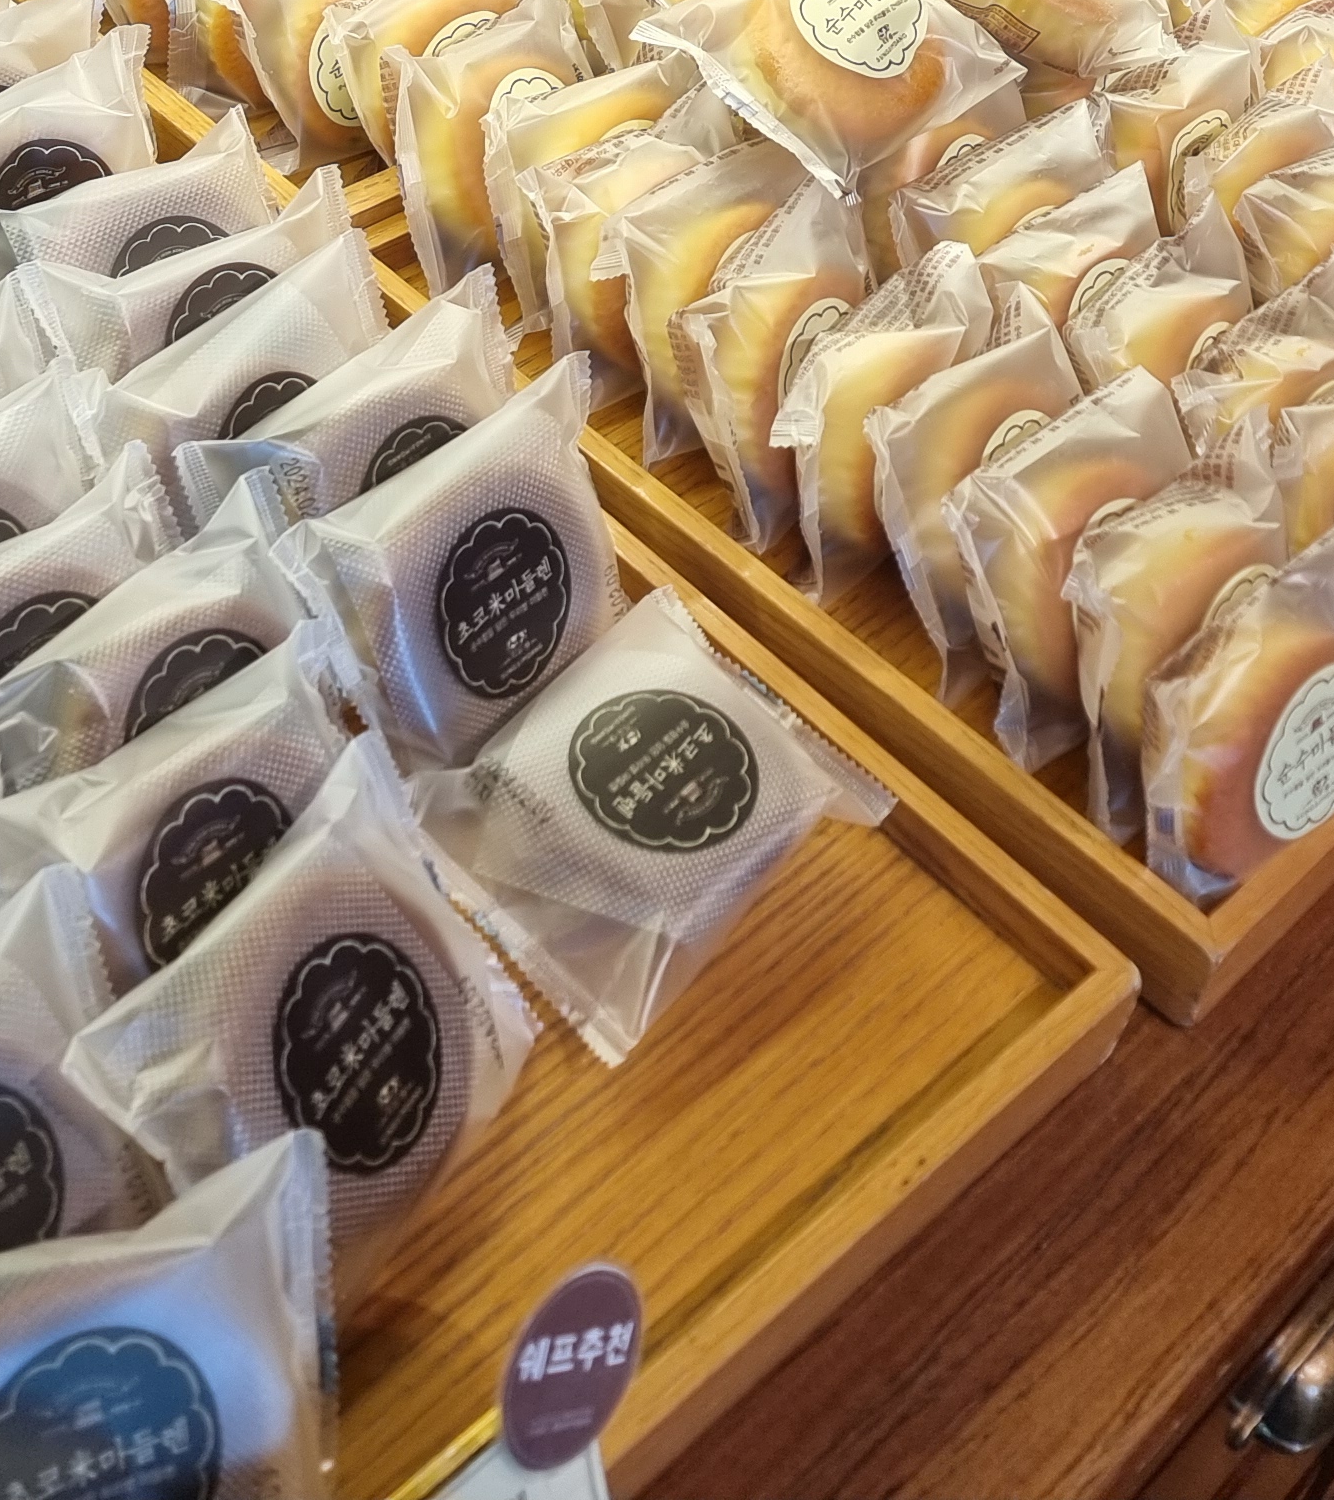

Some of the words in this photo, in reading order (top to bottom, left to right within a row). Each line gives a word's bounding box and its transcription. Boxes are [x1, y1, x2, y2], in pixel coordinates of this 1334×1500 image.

[875, 33, 907, 63] SUNGSIMDANG
[458, 555, 553, 646] 초코米마들렌
[612, 722, 714, 820] 초코米마들렌
